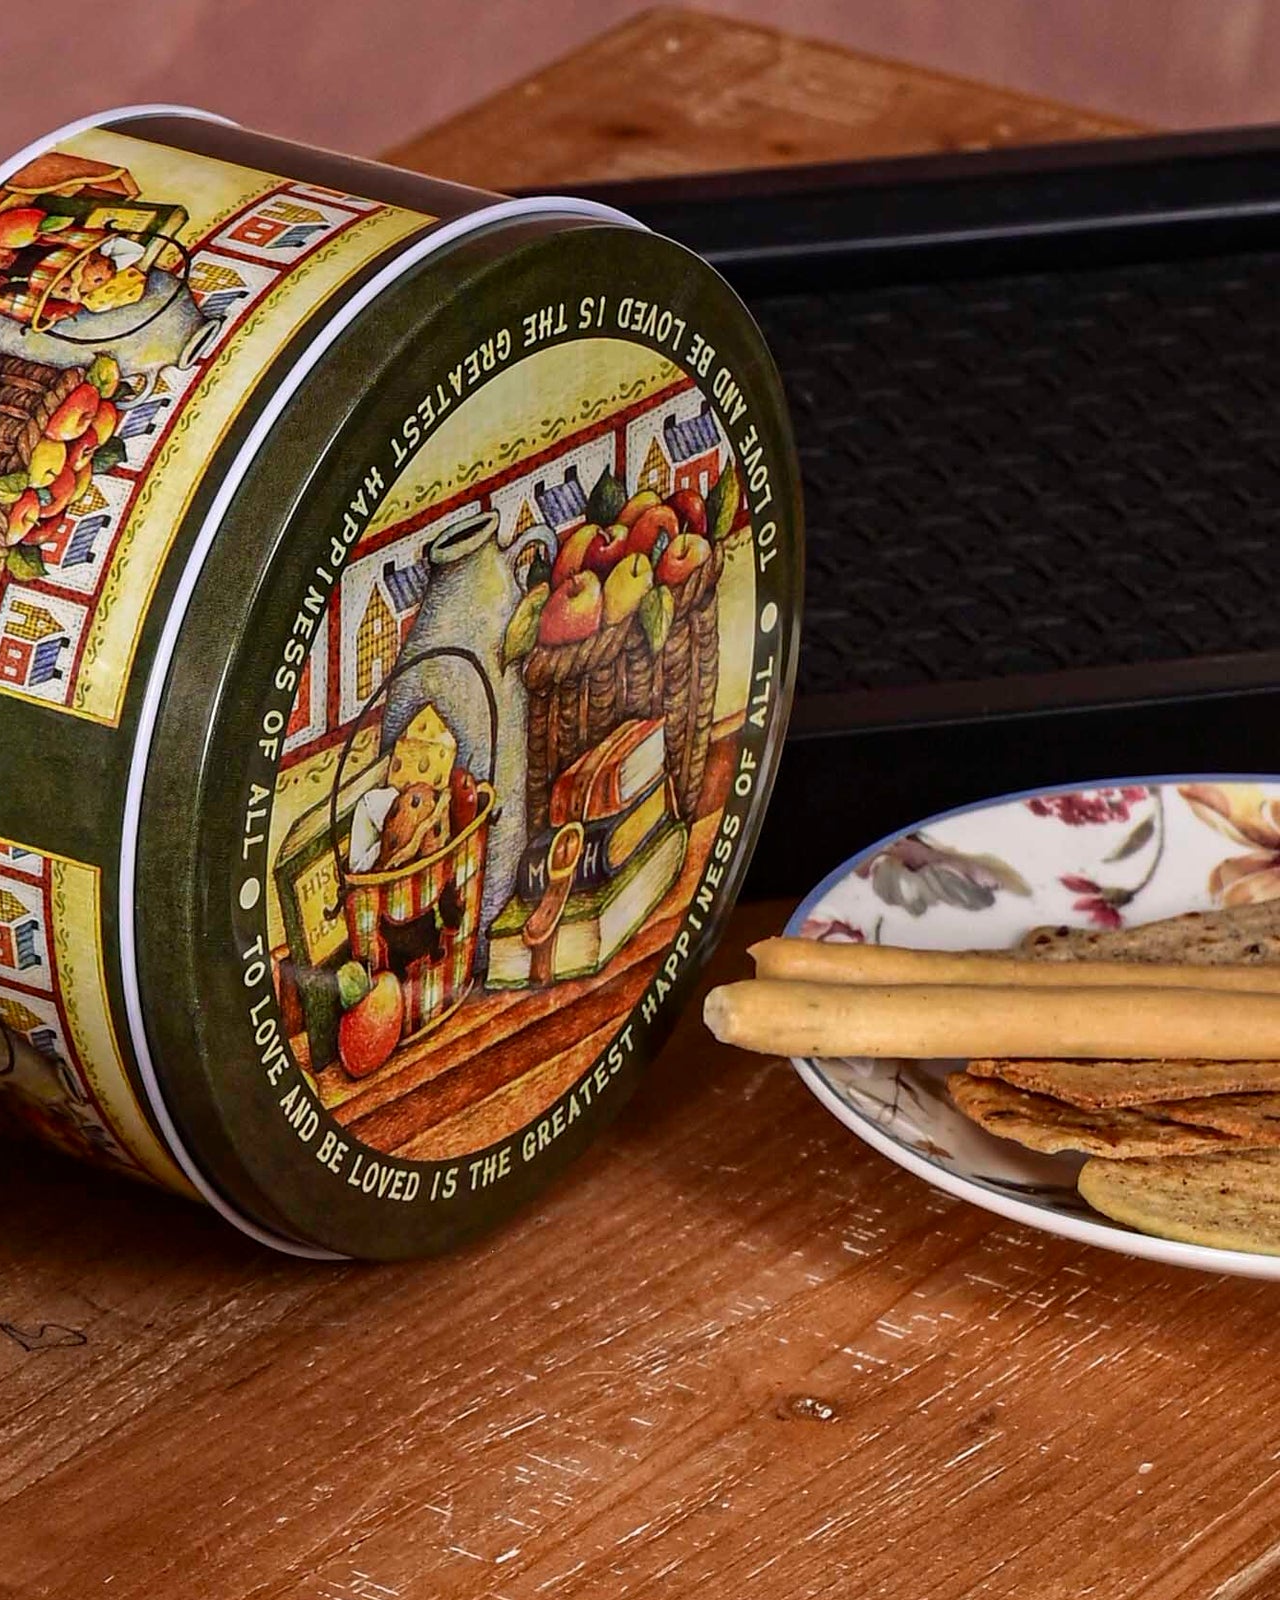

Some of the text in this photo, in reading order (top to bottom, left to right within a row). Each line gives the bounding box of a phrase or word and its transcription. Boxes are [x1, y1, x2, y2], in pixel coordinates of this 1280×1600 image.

[241, 295, 777, 860] TO LOVE AND BE LOVED IS THE GREATEST HAPPINESS OF ALL
[241, 654, 774, 1202] TO LOVE AND BE LOVED IS THE GREATEST HAPPINESS OF ALL
